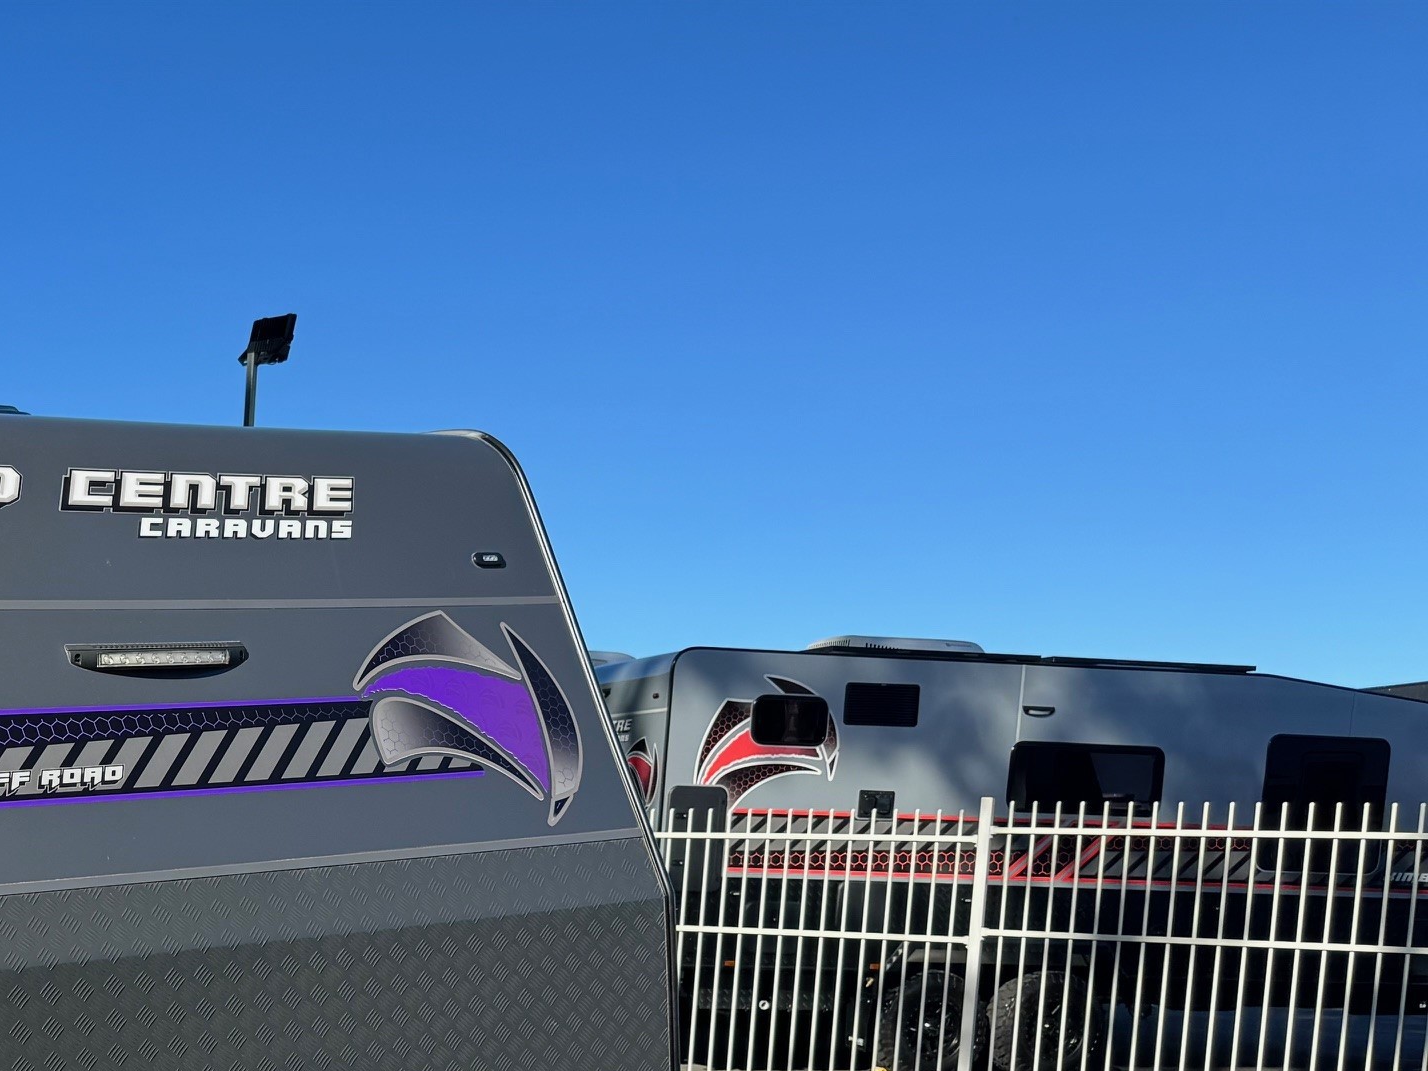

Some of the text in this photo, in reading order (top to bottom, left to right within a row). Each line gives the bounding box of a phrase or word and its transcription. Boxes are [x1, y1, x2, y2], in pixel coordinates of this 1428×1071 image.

[62, 467, 354, 515] CENTRE
[138, 517, 353, 539] CARAVANS
[37, 765, 124, 793] ROAD
